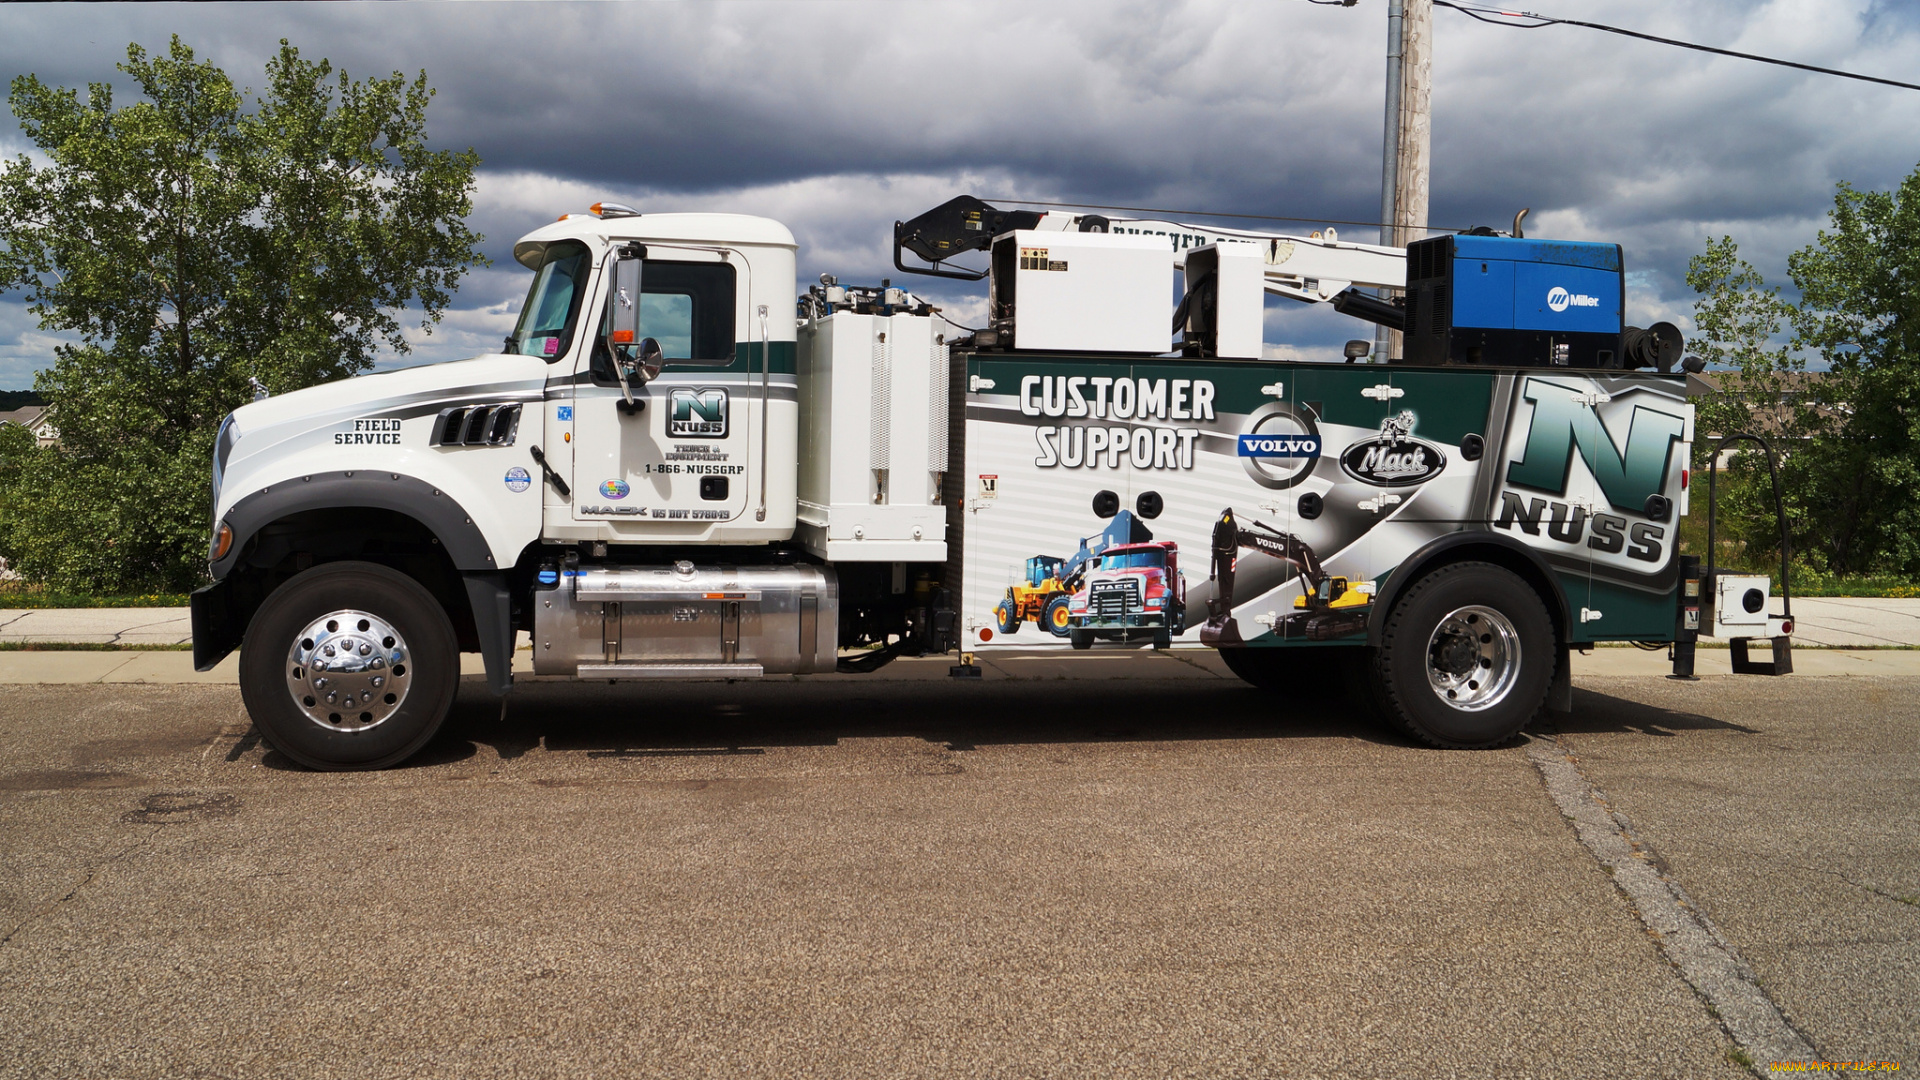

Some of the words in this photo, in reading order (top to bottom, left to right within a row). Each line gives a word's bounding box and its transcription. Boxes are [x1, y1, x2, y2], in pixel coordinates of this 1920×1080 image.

[1570, 294, 1599, 307] Miller
[1020, 375, 1216, 421] CUSTOMER
[673, 394, 723, 421] N
[355, 420, 401, 432] FIELD
[673, 422, 723, 433] NUSS
[335, 433, 401, 445] SERVICE
[1507, 376, 1684, 511] N
[1035, 426, 1199, 470] SUPPORT
[1243, 440, 1317, 453] VOLVO
[1358, 446, 1429, 479] Mack
[645, 464, 744, 475] 1-866-NUSSGRP
[581, 505, 647, 516] MACK
[652, 509, 666, 518] US
[668, 509, 690, 518] DOT
[1494, 491, 1664, 562] NUSS
[1255, 537, 1284, 551] VOLVO
[1095, 583, 1134, 591] MACK
